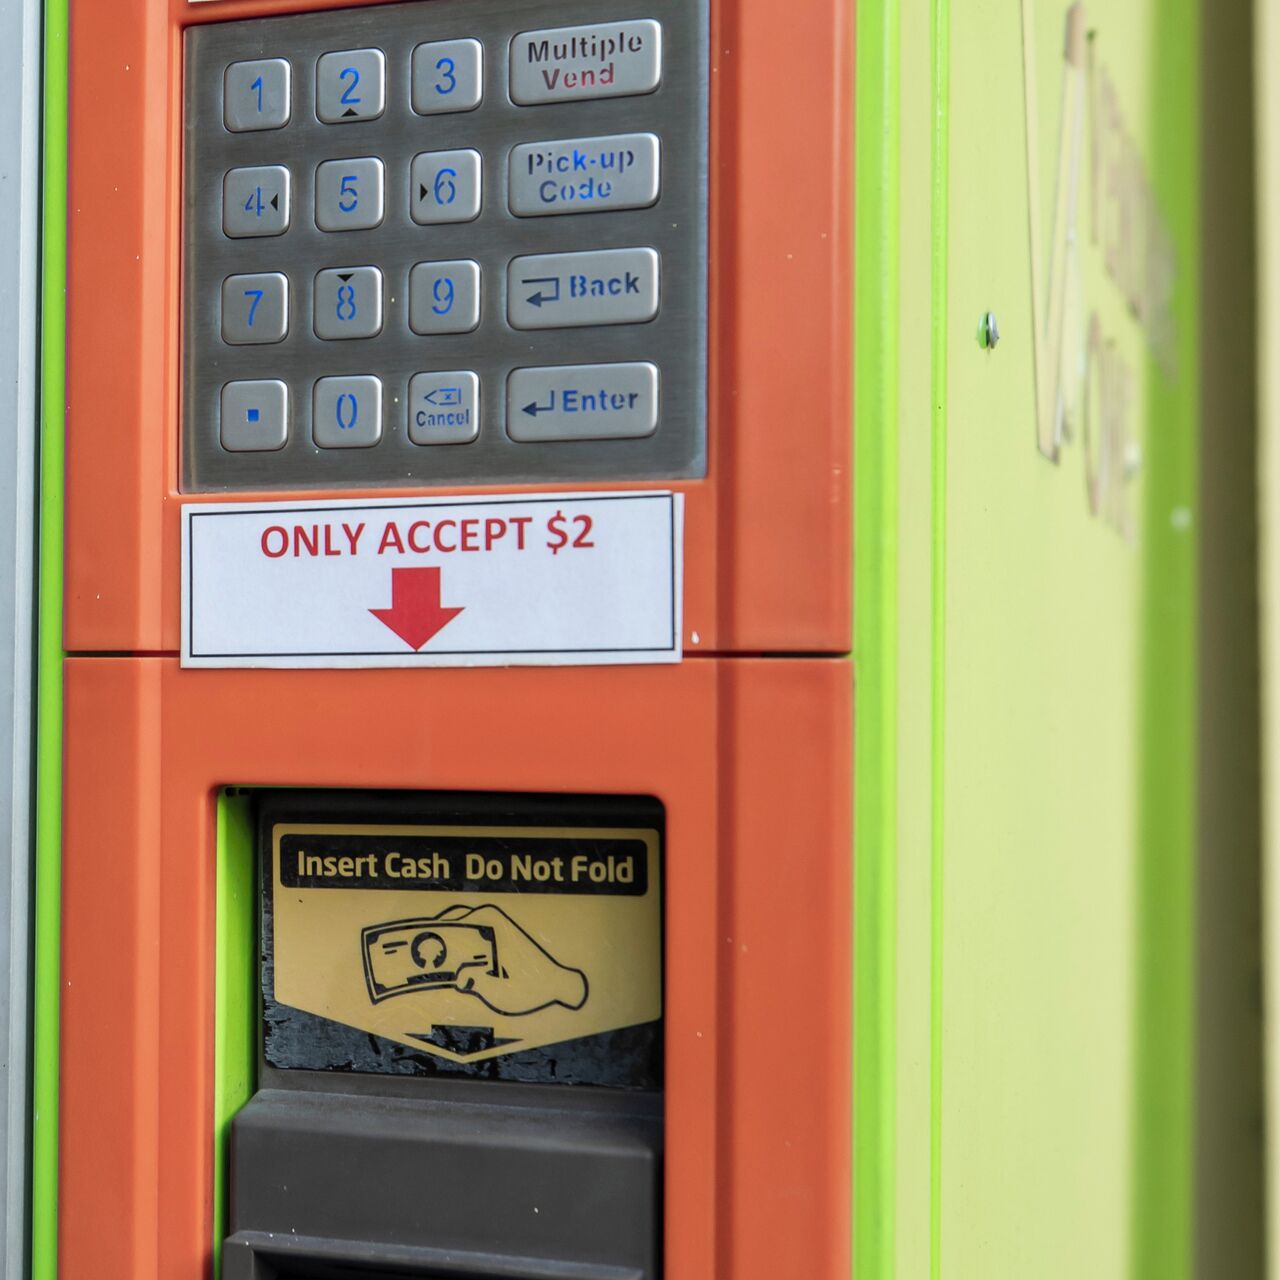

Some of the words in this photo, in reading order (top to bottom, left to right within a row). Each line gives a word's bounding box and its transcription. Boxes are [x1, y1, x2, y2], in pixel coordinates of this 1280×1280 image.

[527, 31, 643, 63] Multiple
[339, 68, 361, 104] 2
[435, 57, 456, 95] 3
[541, 63, 614, 91] Vend
[250, 76, 263, 113] 1
[528, 149, 634, 175] Pick-up
[244, 186, 265, 216] 4
[339, 175, 358, 212] 5
[434, 168, 456, 205] 6
[539, 178, 611, 204] Code
[336, 284, 355, 321] 8
[432, 278, 454, 315] 9
[570, 272, 640, 298] Back
[244, 290, 263, 327] 7
[336, 393, 357, 430] 0
[416, 409, 469, 428] Cancel
[562, 389, 638, 413] Enter
[260, 522, 366, 558] ONLY
[377, 516, 533, 555] ACCEPT
[546, 510, 595, 555] $2
[298, 851, 377, 878] Insert
[385, 852, 449, 880] Cash
[466, 854, 503, 881] Do
[511, 855, 564, 882] Not
[571, 856, 634, 884] Fold
